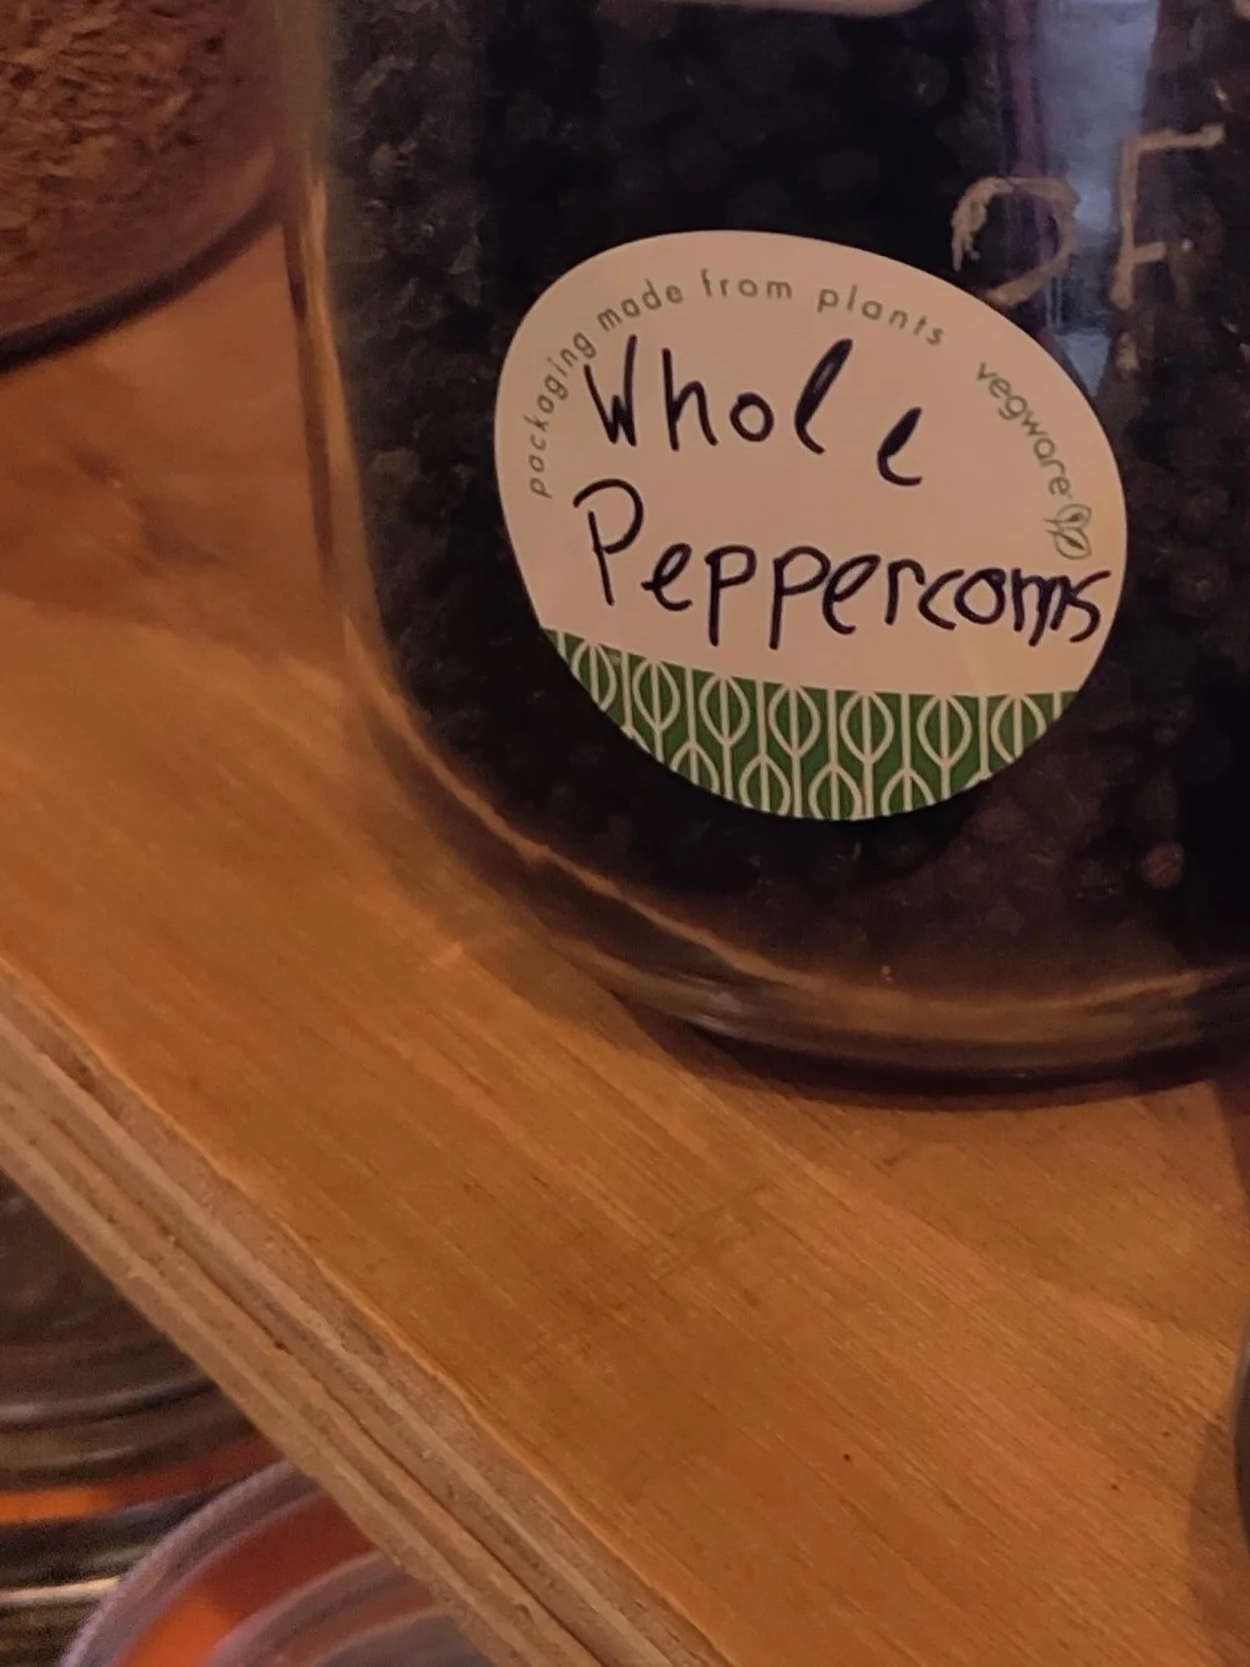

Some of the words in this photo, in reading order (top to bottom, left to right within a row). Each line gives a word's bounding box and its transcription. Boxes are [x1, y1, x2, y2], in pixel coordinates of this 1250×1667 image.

[523, 331, 598, 499] packaging
[595, 278, 685, 332] made
[700, 267, 793, 301] from
[816, 283, 944, 346] plants
[583, 333, 923, 487] Whole
[975, 361, 1071, 497] vegware
